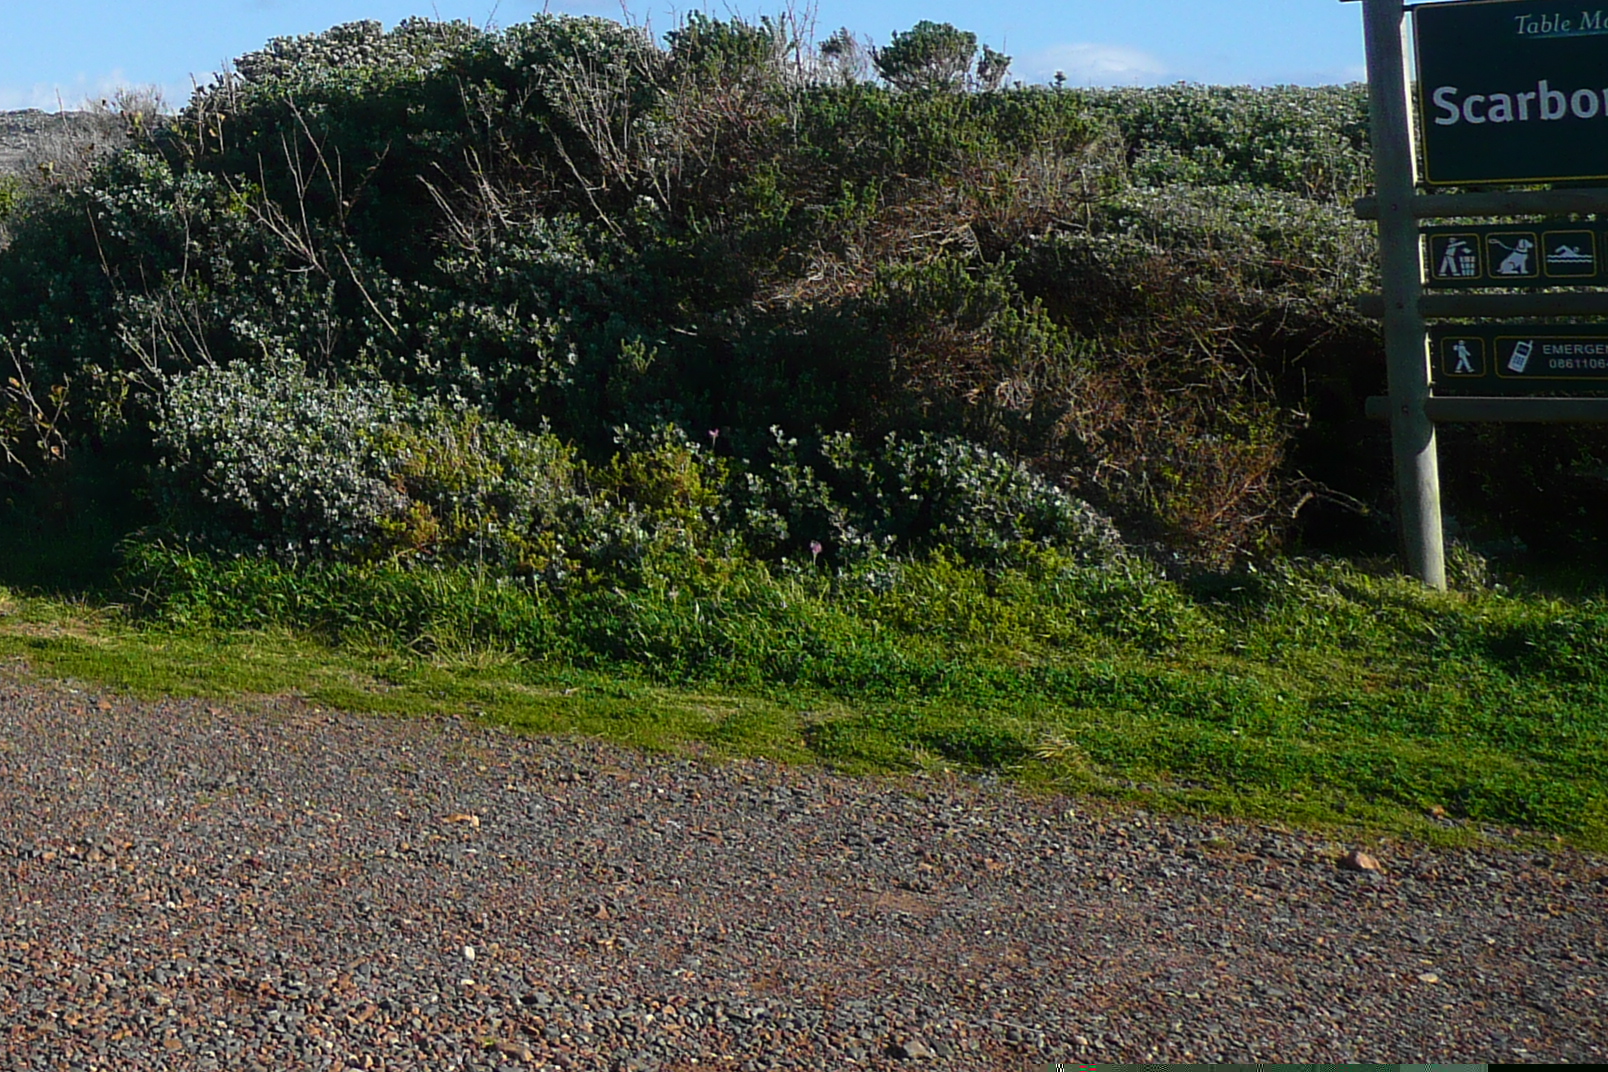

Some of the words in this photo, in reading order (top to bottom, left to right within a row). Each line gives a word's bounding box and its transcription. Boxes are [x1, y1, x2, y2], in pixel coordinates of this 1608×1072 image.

[1514, 13, 1571, 34] Table
[1542, 344, 1608, 355] EMERGE
[1549, 358, 1608, 369] 0861106
